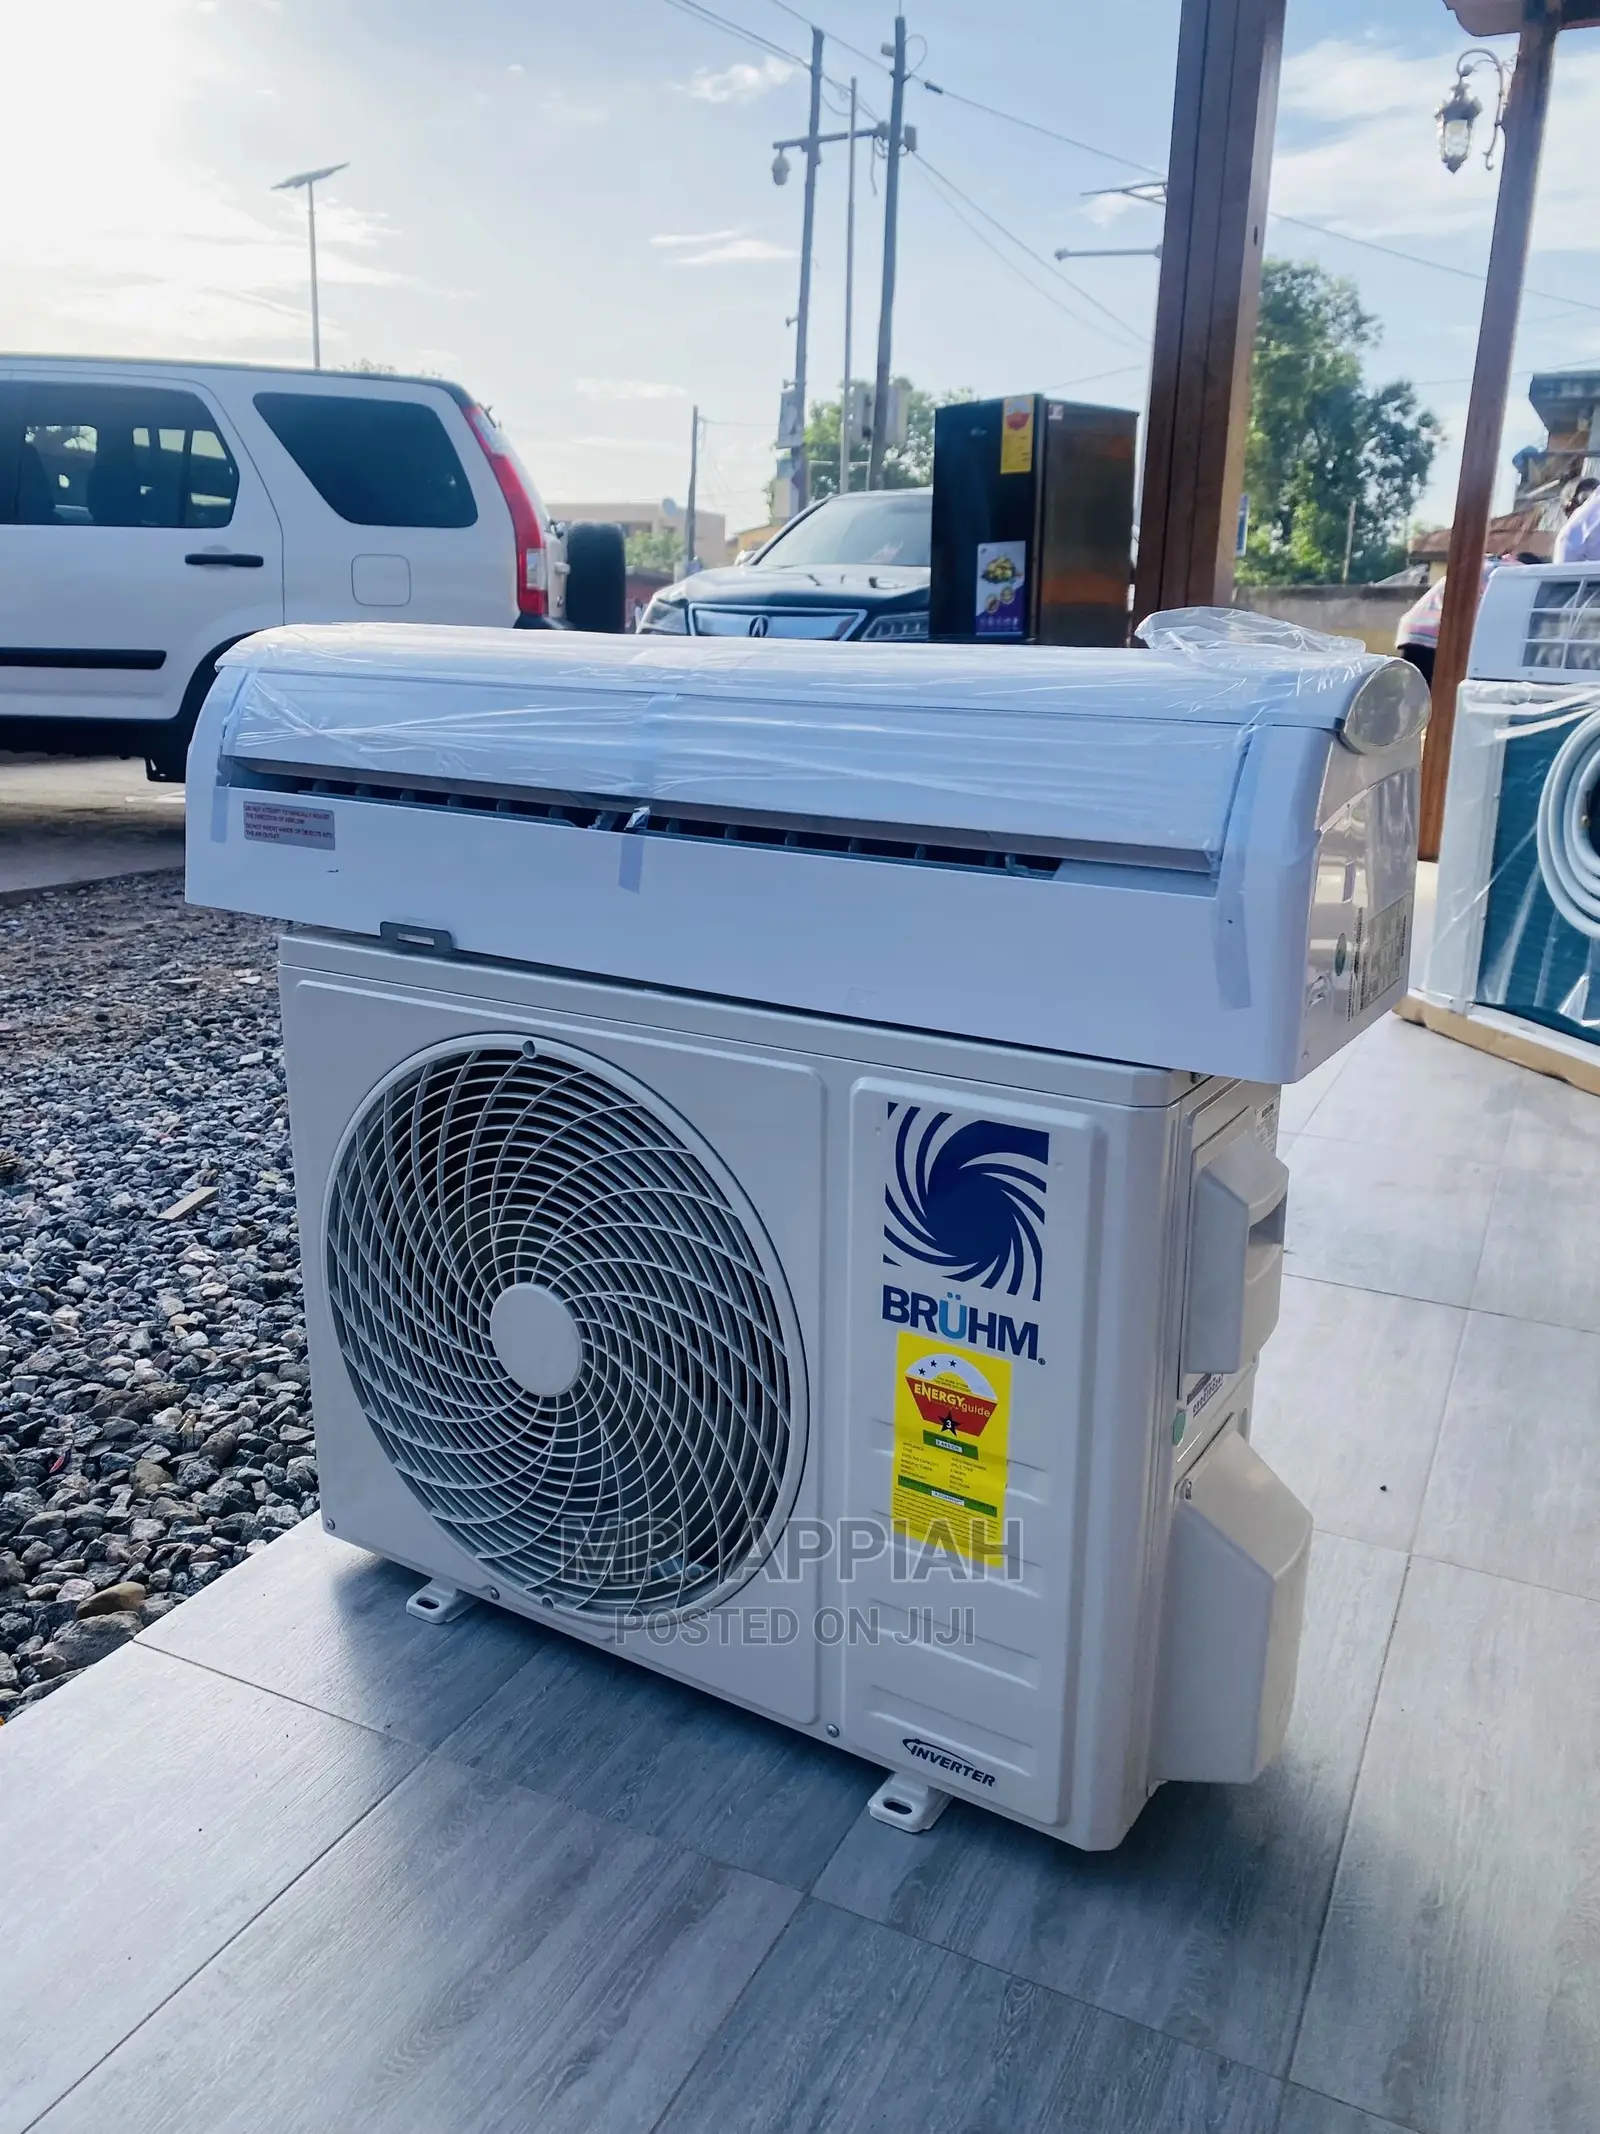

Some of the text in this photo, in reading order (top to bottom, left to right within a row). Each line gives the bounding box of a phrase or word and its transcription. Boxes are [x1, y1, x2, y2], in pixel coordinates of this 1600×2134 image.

[914, 1382, 966, 1407] ENERGY
[962, 1403, 991, 1418] guide
[946, 1420, 952, 1429] 3
[911, 1744, 996, 1788] INVERTER
